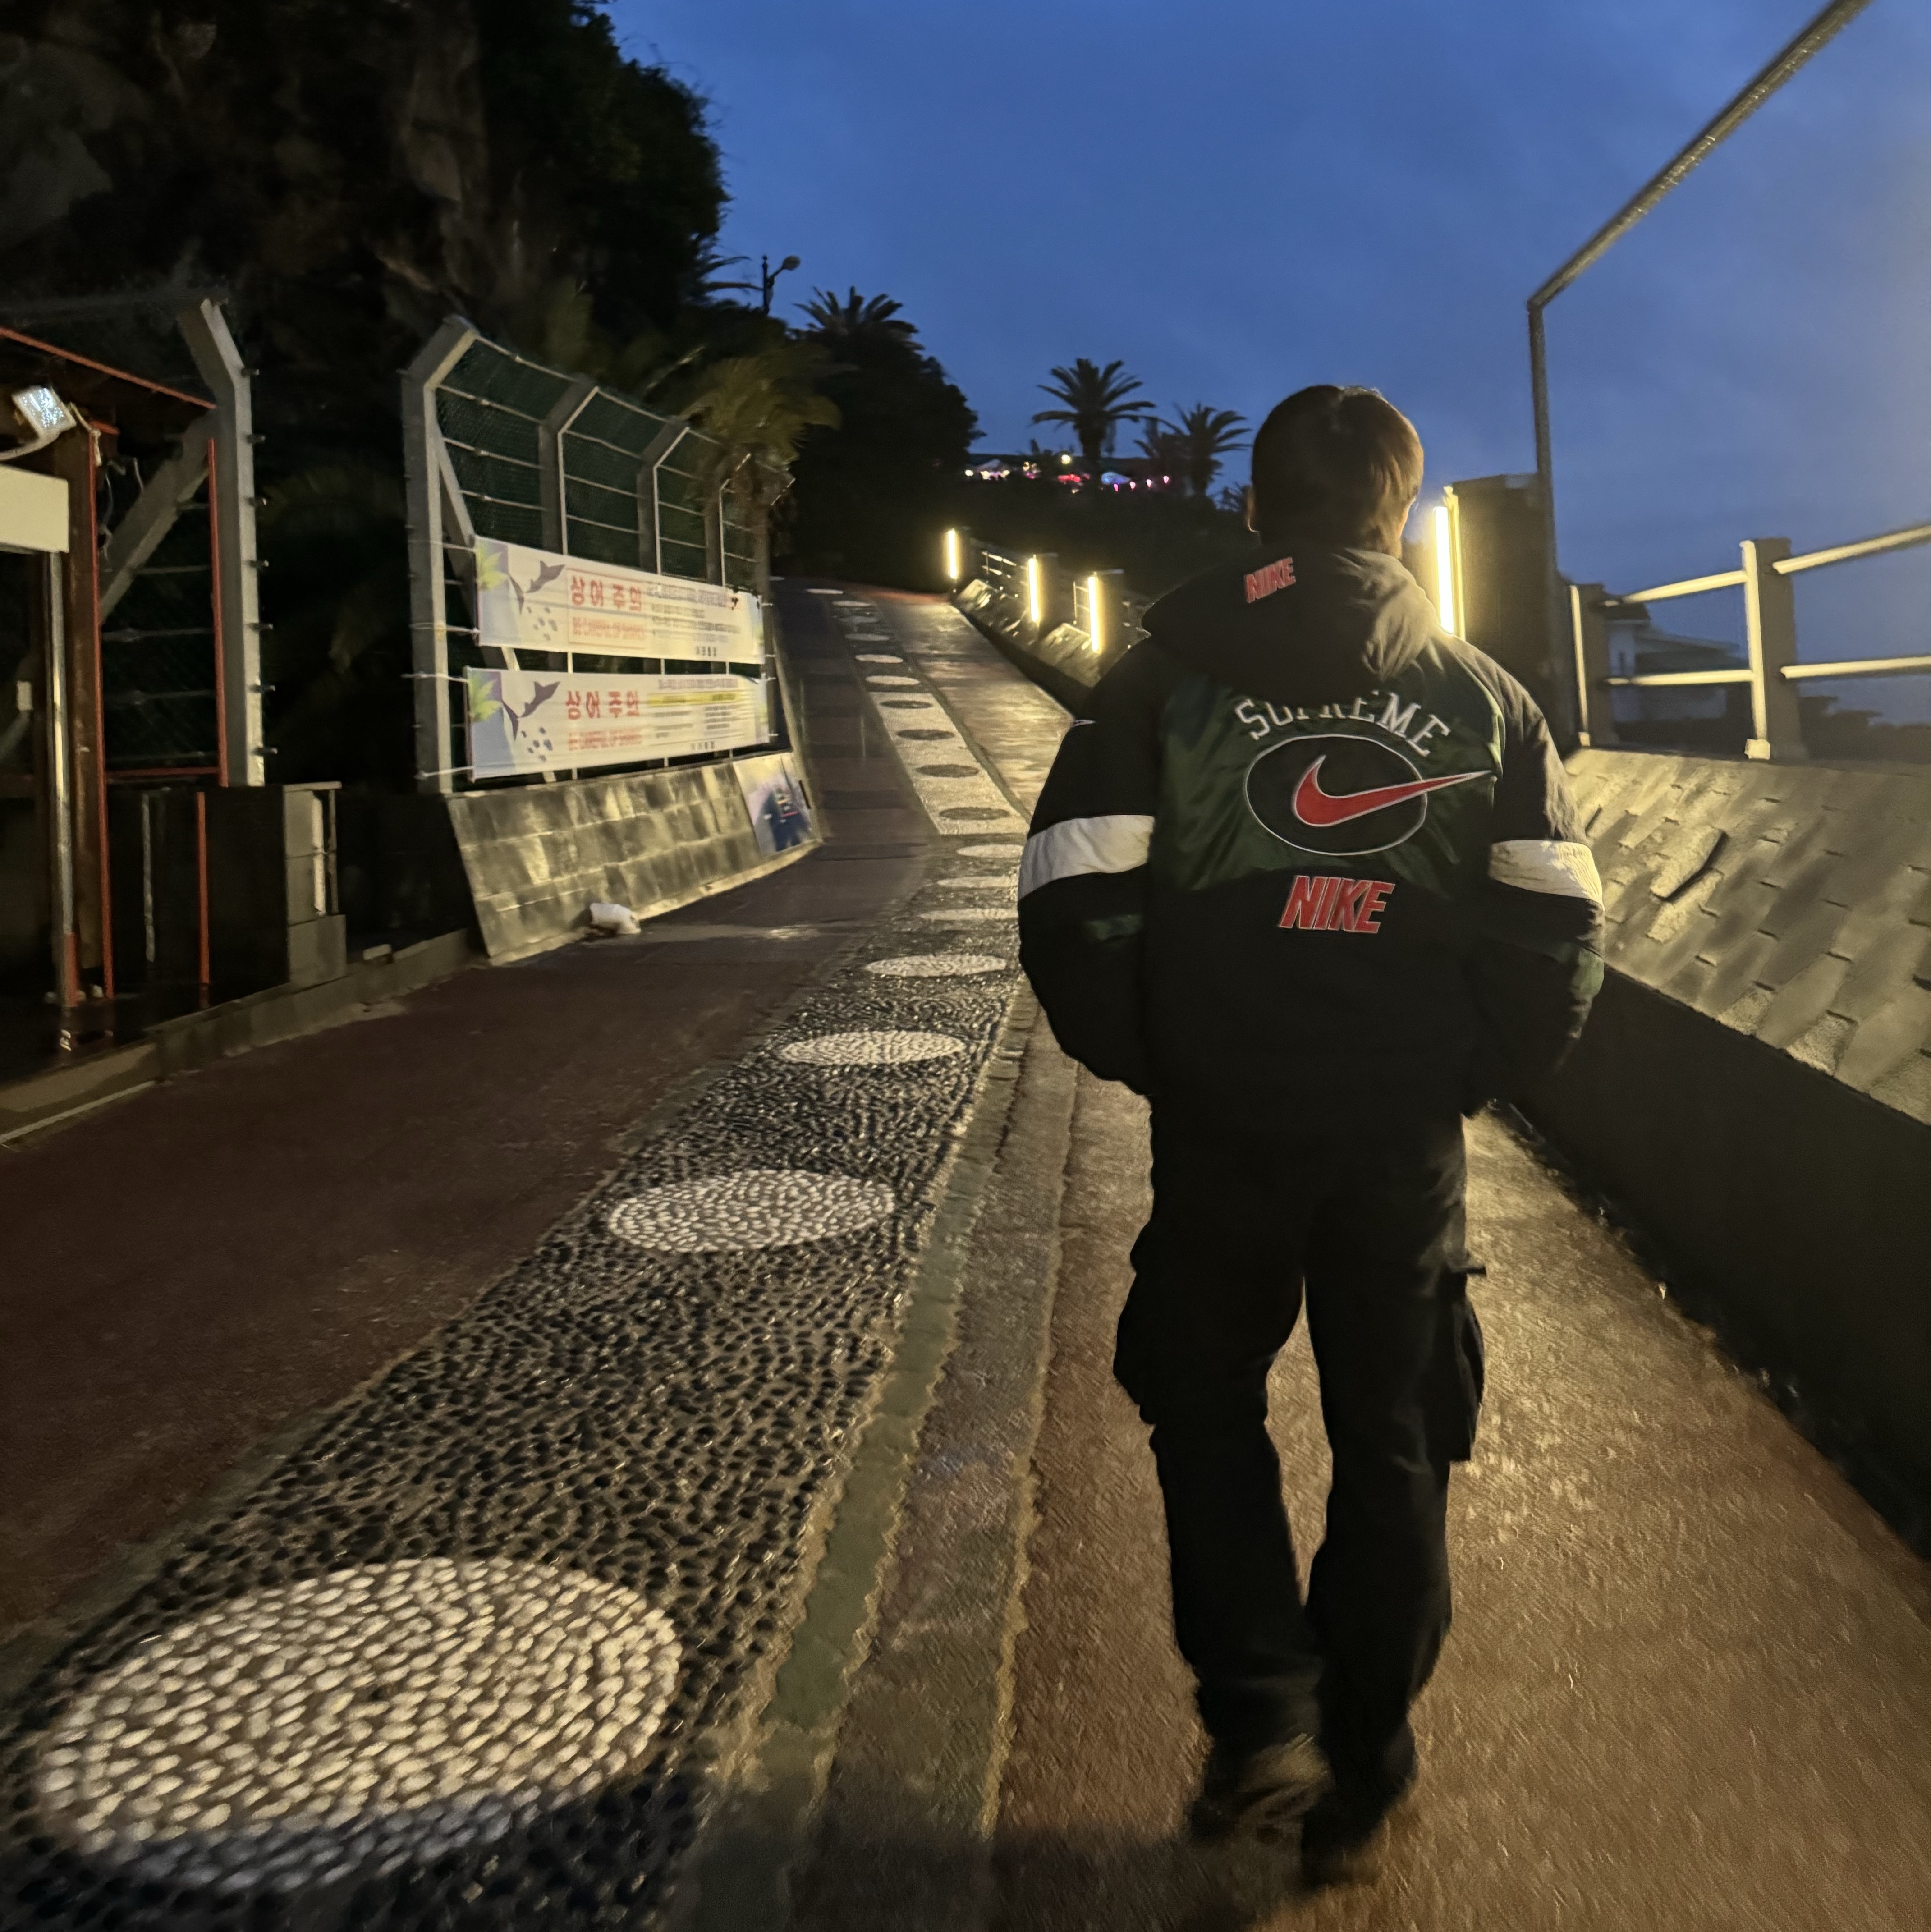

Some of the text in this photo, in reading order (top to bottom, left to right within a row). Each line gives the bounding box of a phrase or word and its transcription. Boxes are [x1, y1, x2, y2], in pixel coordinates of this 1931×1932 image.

[1244, 557, 1296, 603] NIKE
[565, 690, 600, 720] 상어
[1278, 875, 1395, 933] NIKE
